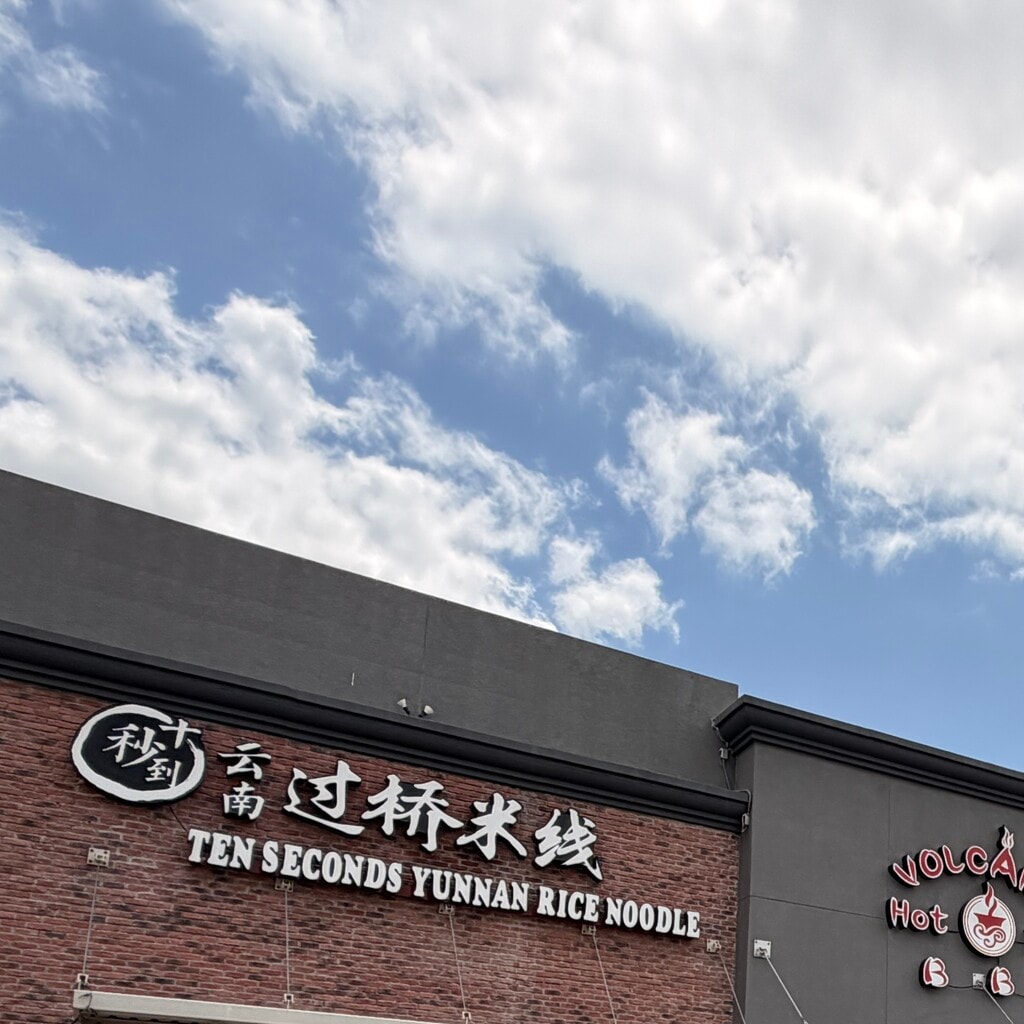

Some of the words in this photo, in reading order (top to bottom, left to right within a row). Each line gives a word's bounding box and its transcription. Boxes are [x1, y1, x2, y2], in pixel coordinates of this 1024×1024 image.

[217, 742, 272, 821] 云南
[282, 759, 603, 882] 过桥米线
[188, 828, 257, 871] TEN
[261, 839, 403, 895] SECONDS
[412, 864, 530, 912] YUNNAN
[537, 885, 600, 923] RICE
[604, 896, 701, 939] NOODLE
[889, 896, 949, 935] Hot
